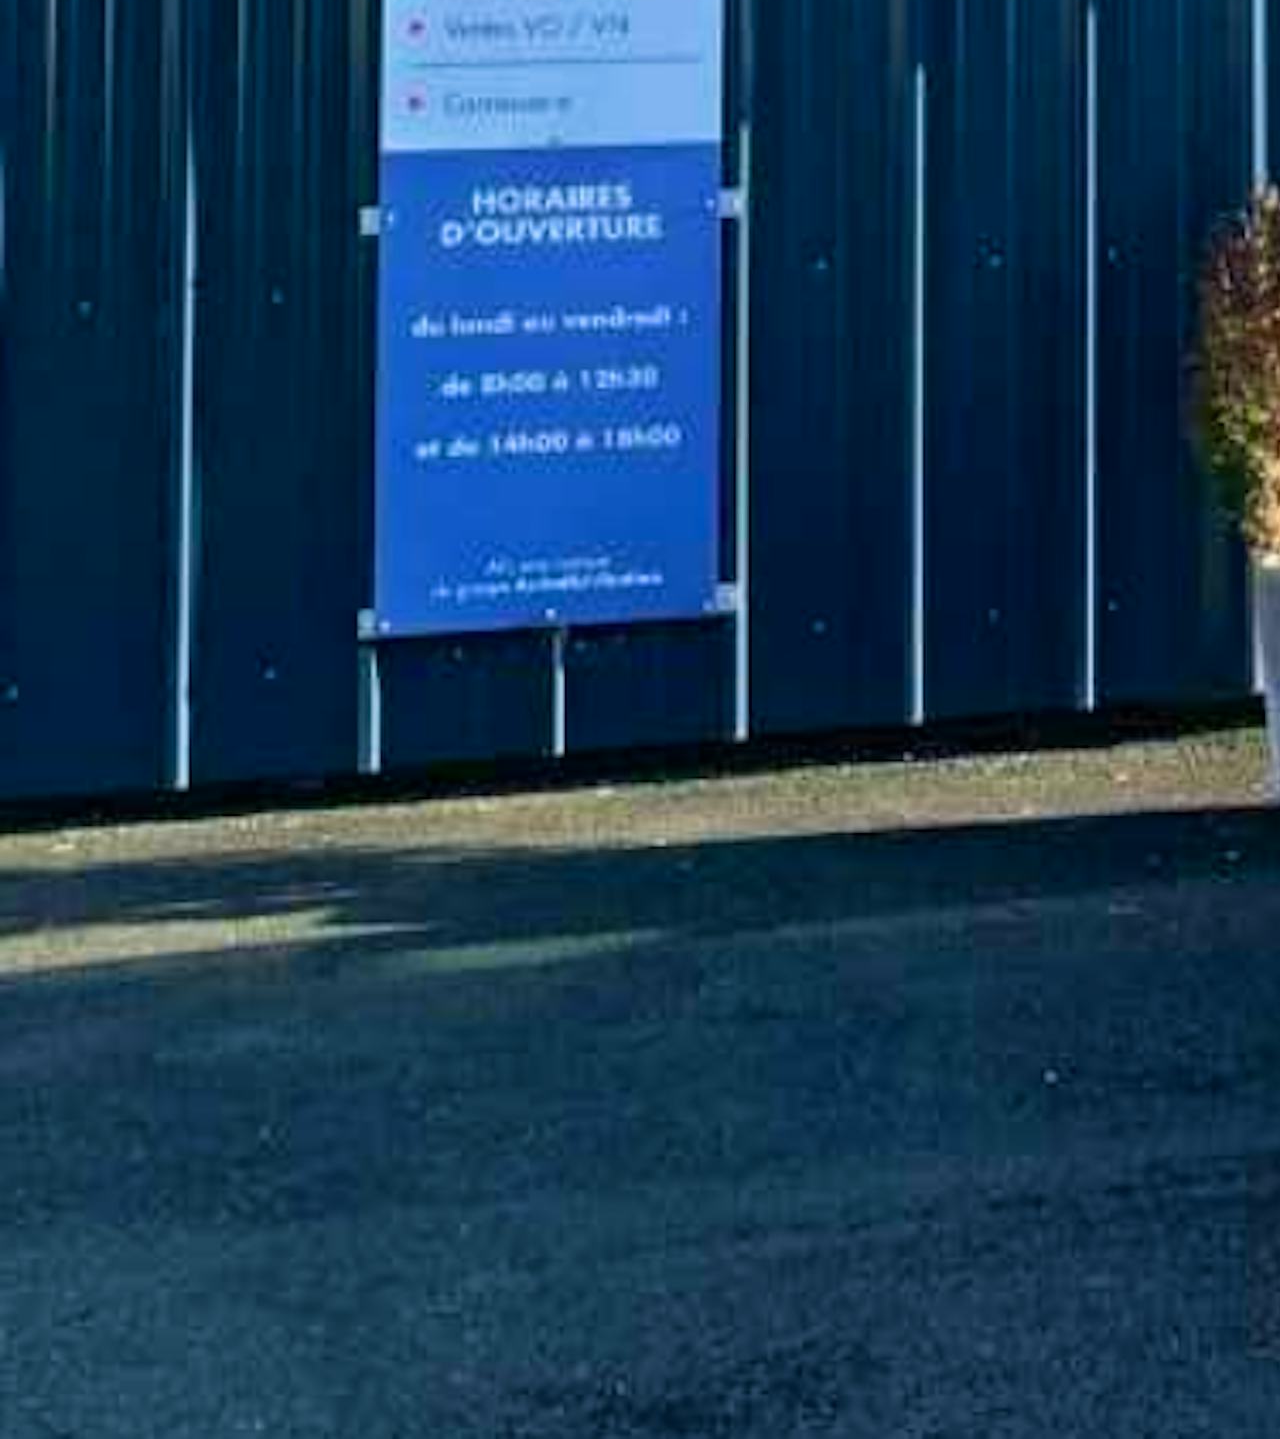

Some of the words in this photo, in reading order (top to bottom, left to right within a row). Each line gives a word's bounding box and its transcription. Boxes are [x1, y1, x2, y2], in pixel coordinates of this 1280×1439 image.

[473, 184, 633, 214] HORAIRES
[438, 215, 664, 247] D'OUVERTURE
[440, 372, 473, 397] de
[490, 432, 570, 456] 14h00
